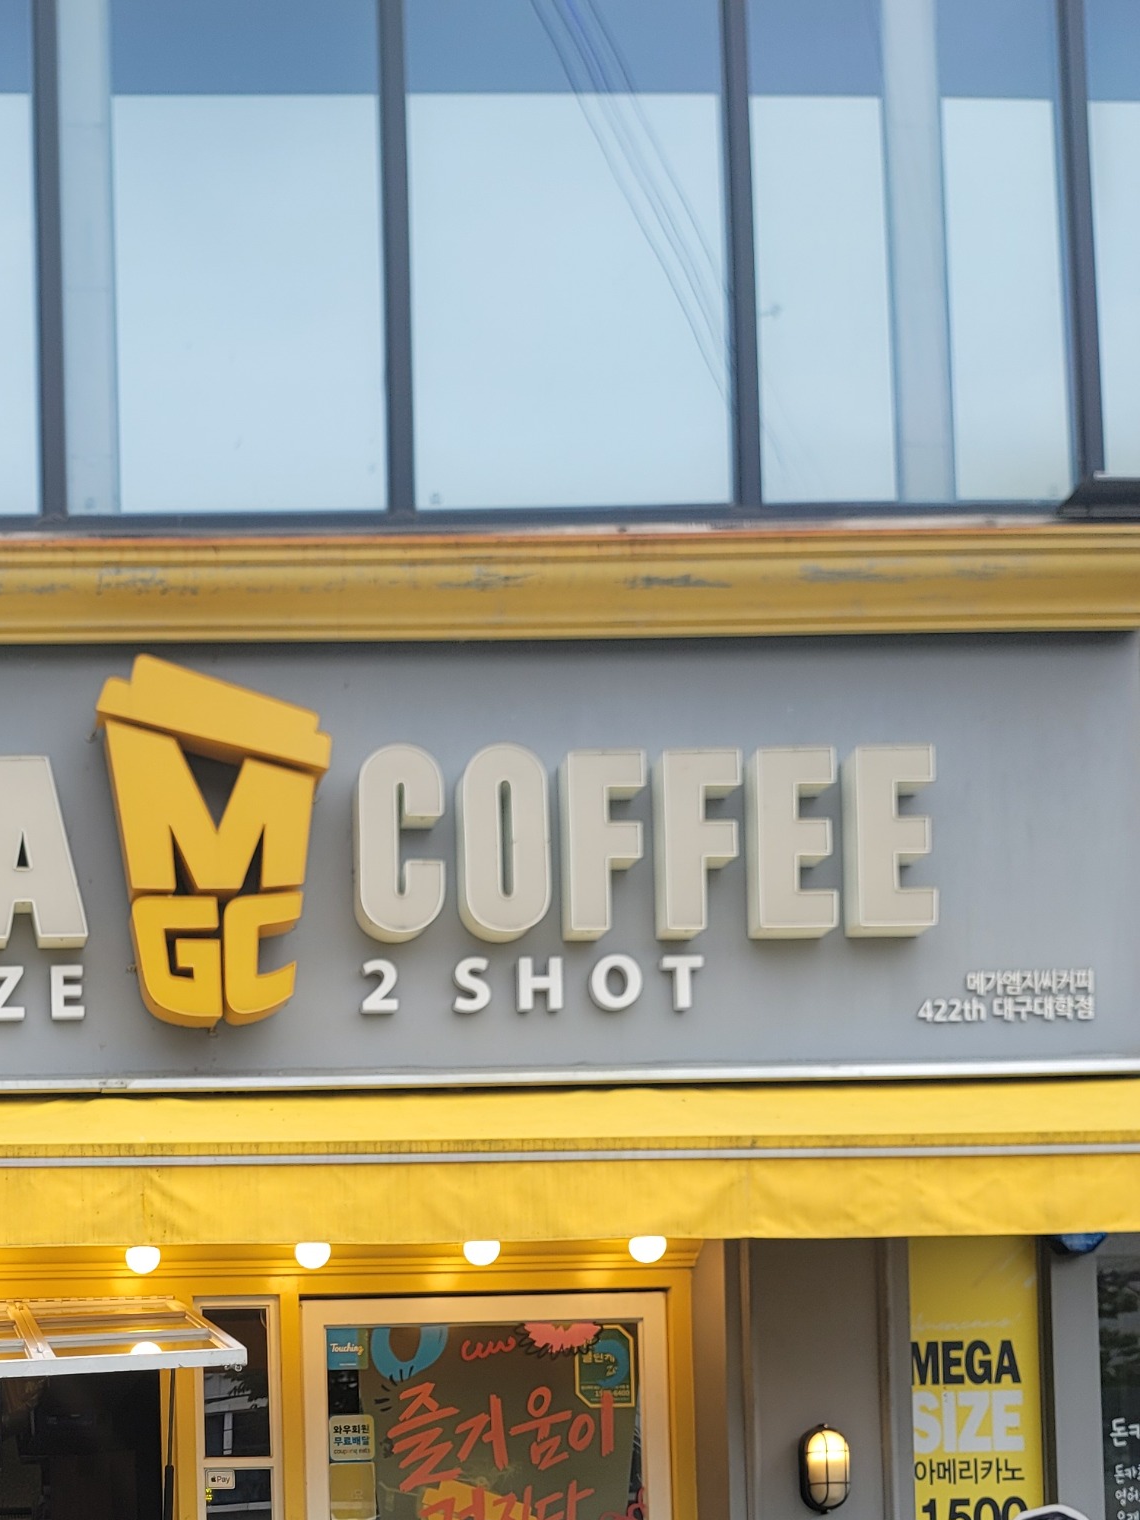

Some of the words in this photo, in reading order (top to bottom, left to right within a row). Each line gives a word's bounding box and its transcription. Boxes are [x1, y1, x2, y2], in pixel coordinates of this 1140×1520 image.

[353, 743, 939, 944] COFFEE
[361, 957, 400, 1015] 2
[453, 954, 705, 1014] SHOT
[916, 996, 987, 1023] 422th
[992, 994, 1096, 1022] 대구대학점
[330, 1342, 364, 1356] Touching
[911, 1340, 1022, 1386] MEGA
[333, 1424, 370, 1435] 와우회원
[387, 1381, 614, 1492] 즐거움이
[912, 1389, 1025, 1455] SIZE
[333, 1435, 370, 1447] 무료배달
[914, 1458, 1025, 1485] 아메리카노
